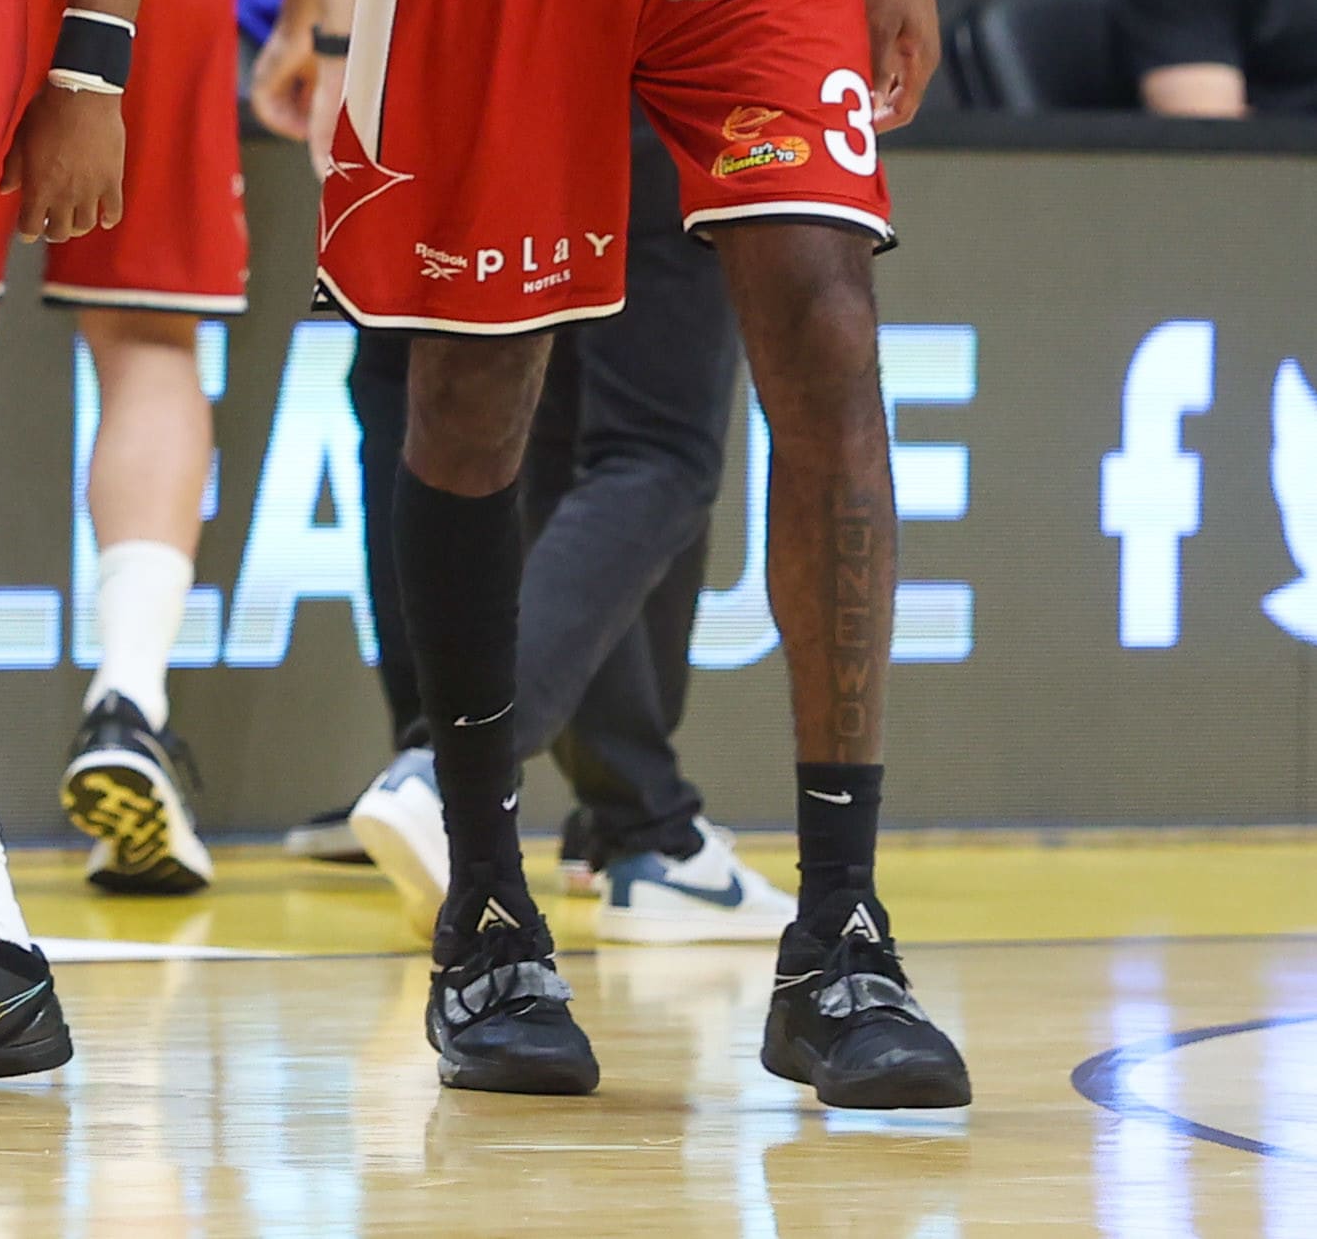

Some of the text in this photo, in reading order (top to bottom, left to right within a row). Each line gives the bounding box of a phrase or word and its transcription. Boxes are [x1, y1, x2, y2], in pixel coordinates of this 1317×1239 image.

[820, 68, 877, 177] 3
[415, 242, 468, 268] Reebok
[522, 268, 571, 294] HOTELS
